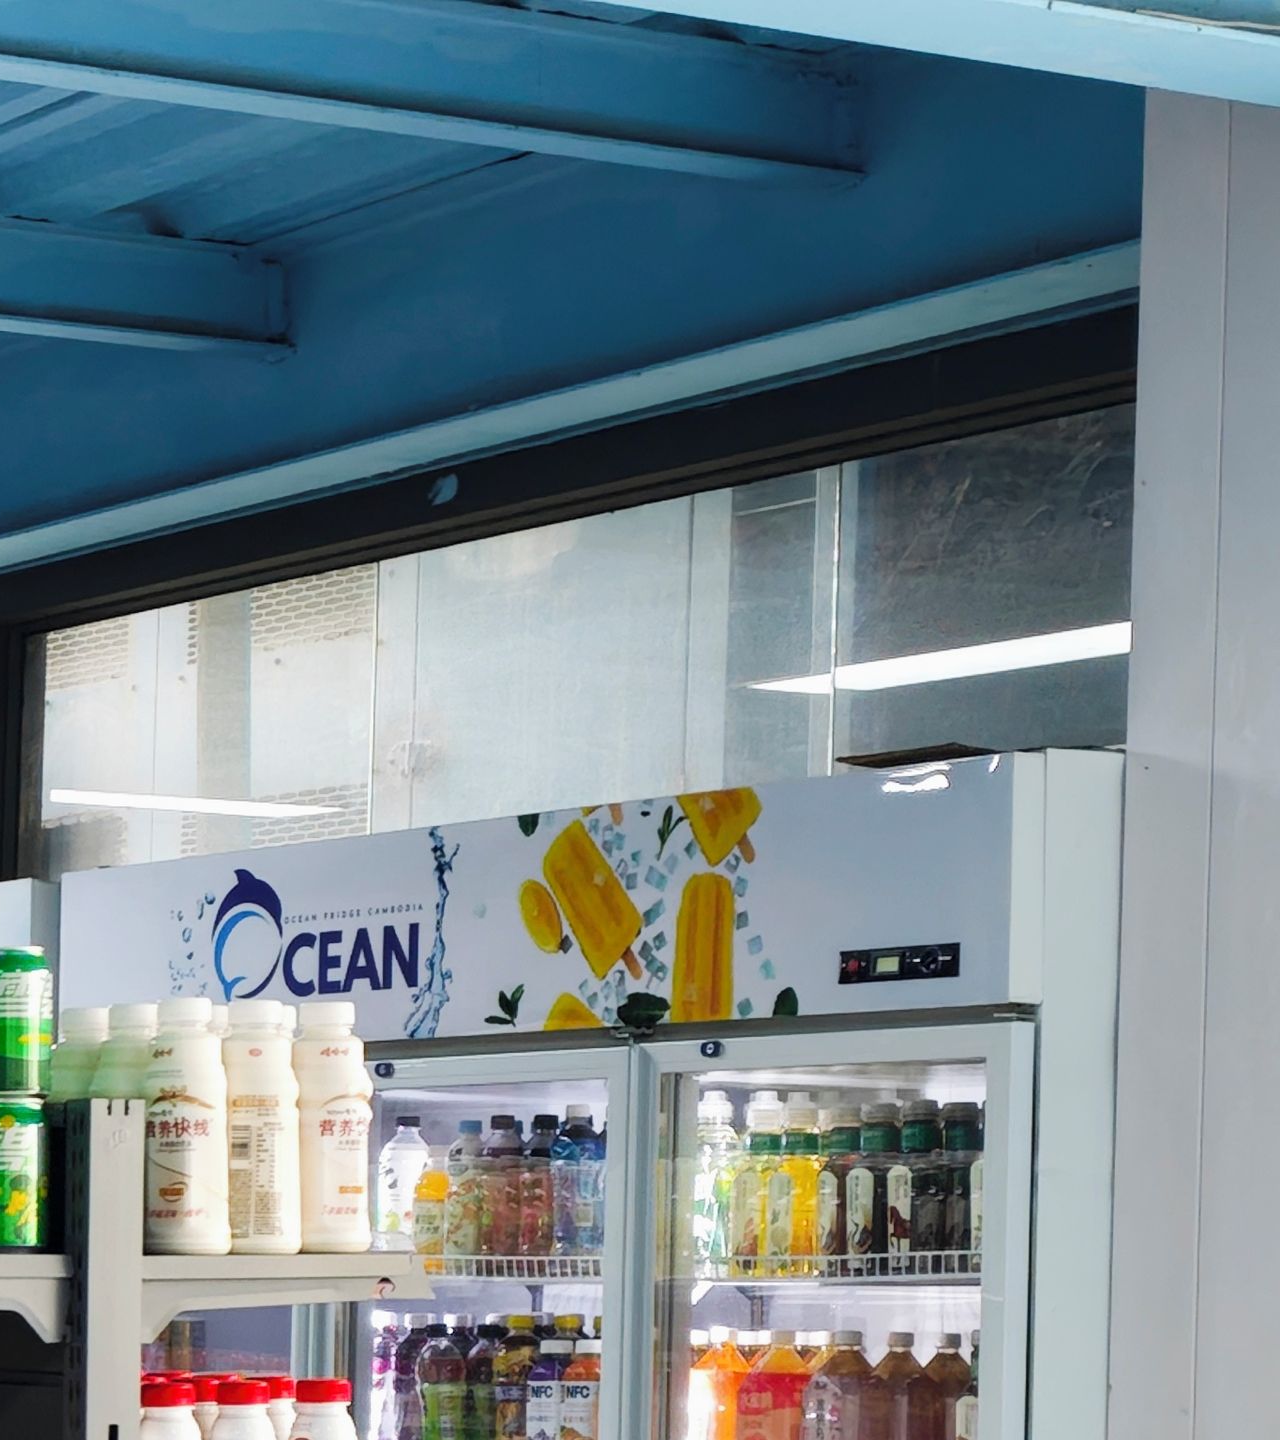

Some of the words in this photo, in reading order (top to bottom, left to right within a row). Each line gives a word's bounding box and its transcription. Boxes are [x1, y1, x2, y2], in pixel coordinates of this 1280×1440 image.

[284, 912, 318, 925] OCEAN
[324, 909, 361, 921] FRIDGE
[368, 903, 424, 916] CAMBODIA
[531, 1385, 553, 1398] NFC
[566, 1385, 590, 1398] NFC
